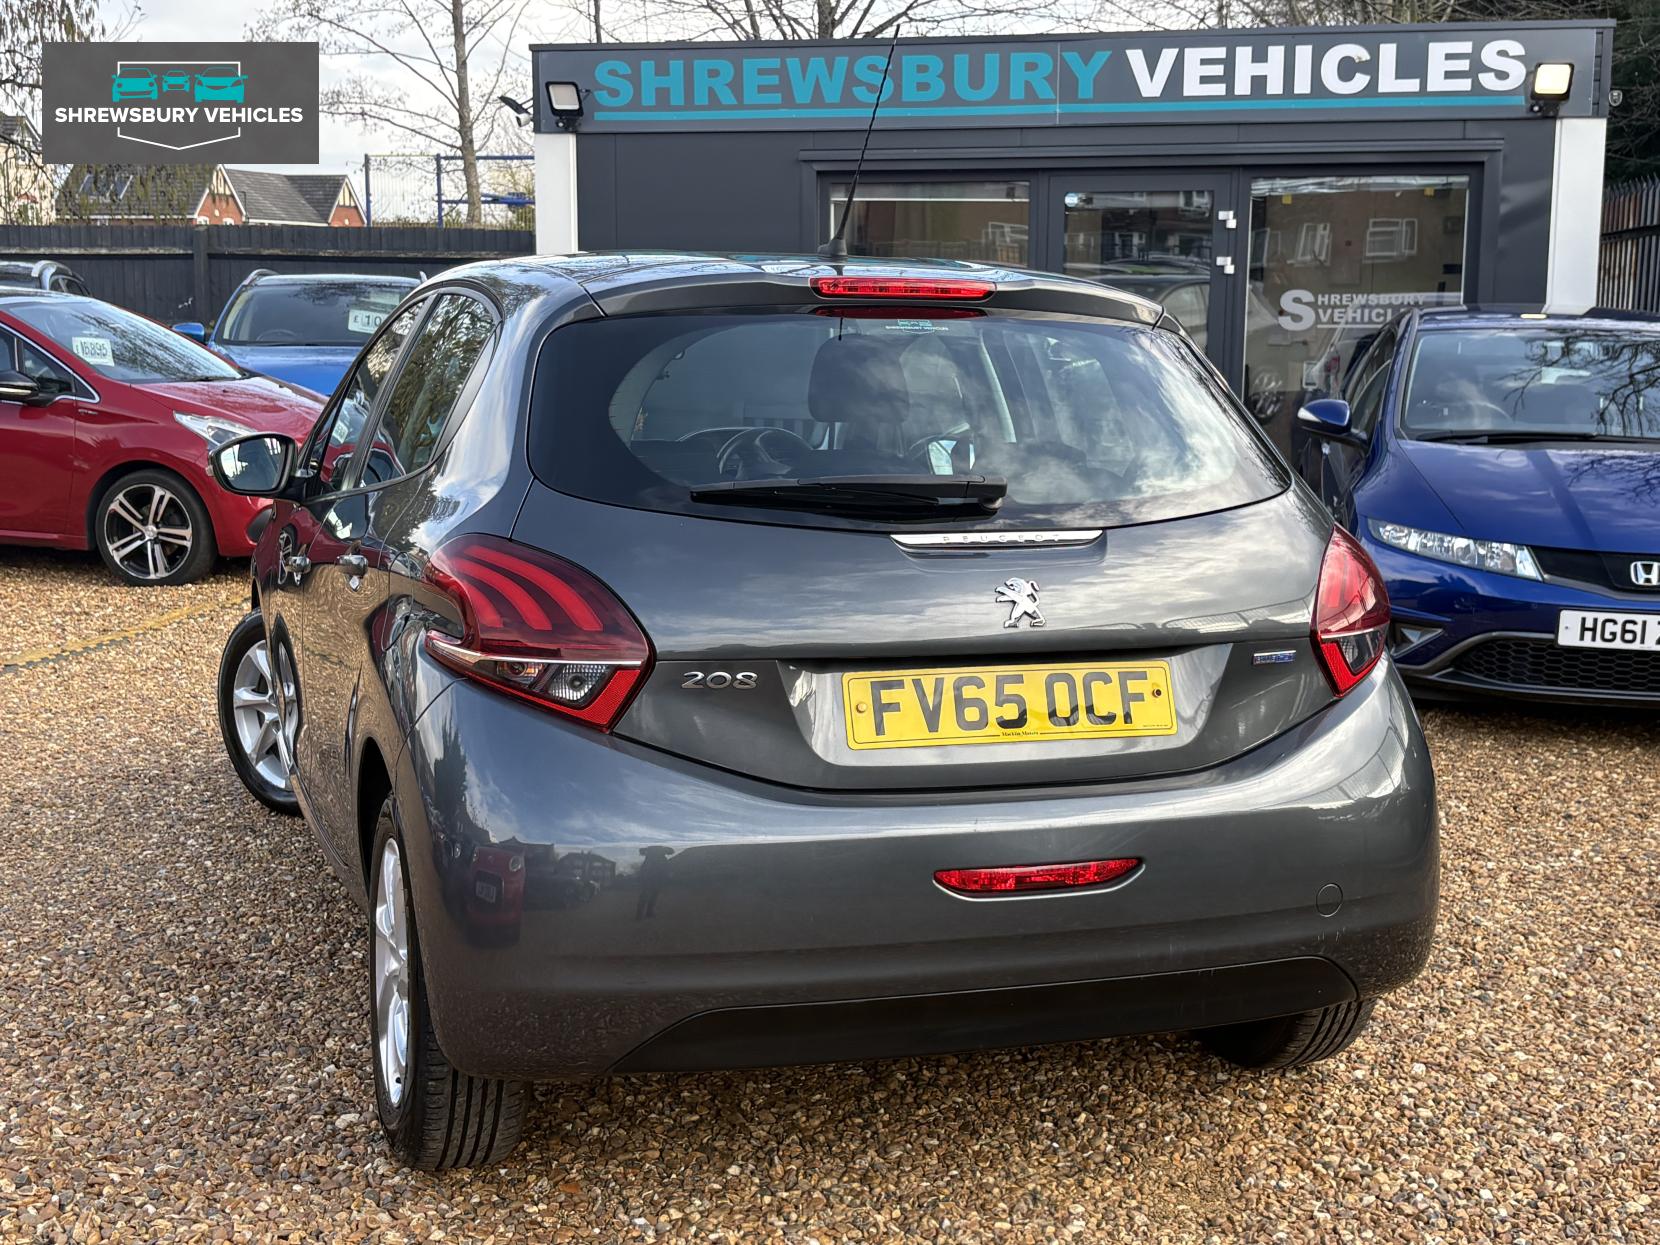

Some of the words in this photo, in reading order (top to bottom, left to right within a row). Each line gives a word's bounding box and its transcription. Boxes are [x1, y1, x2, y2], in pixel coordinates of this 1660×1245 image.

[594, 50, 1113, 108] SHREWSBURY
[1125, 39, 1527, 98] VEHICLES
[1317, 308, 1406, 323] VEHICL
[942, 533, 1060, 544] PEUGEOT
[1578, 616, 1647, 645] HG61
[681, 671, 758, 689] 208
[870, 674, 1028, 736] FV65
[1044, 671, 1149, 728] OCF
